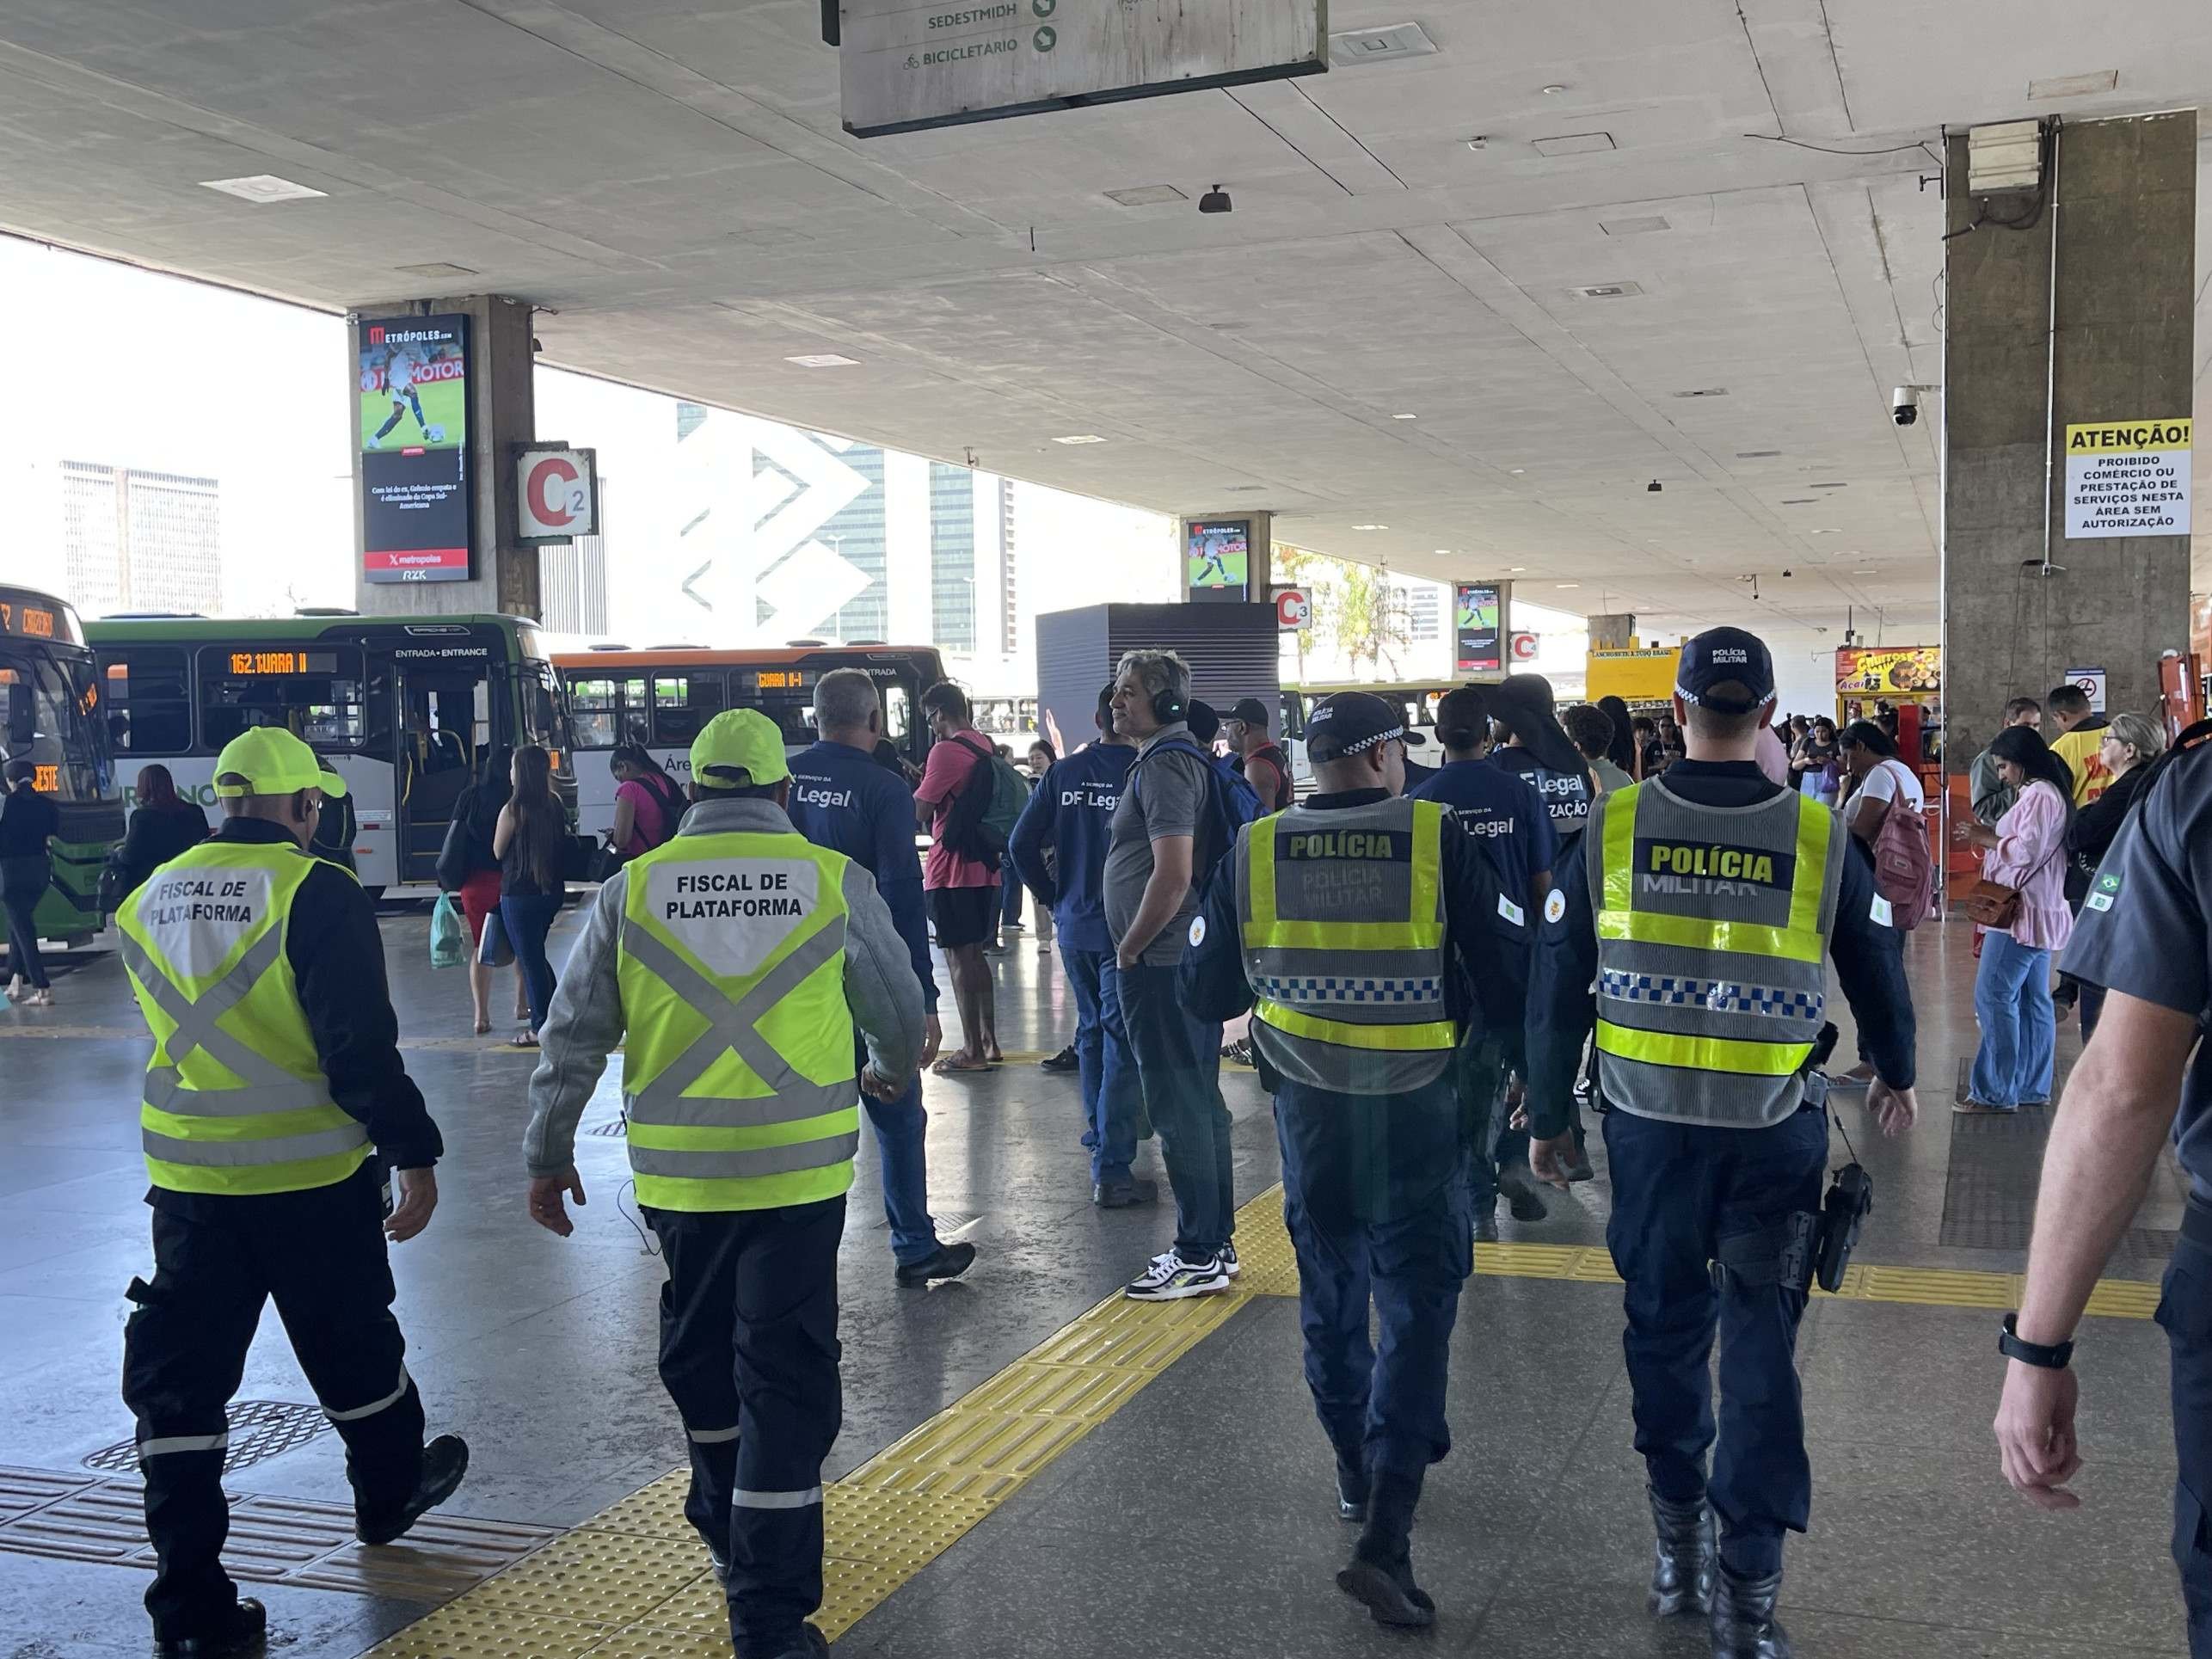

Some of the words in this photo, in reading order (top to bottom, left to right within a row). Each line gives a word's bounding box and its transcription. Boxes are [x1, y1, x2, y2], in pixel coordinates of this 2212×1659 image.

[928, 3, 1017, 29] SEDESTMIDH
[2071, 424, 2190, 450] ATENÇÃO!
[2098, 456, 2160, 467] PROIBIDO
[2083, 469, 2151, 480] COMÉRCIO
[2156, 468, 2174, 476] OU
[2080, 480, 2156, 492] PRESTAÇÃO
[2160, 480, 2178, 488] DE
[572, 490, 586, 511] 2
[2074, 495, 2137, 505] SERVIÇOS
[2141, 492, 2184, 502] NESTA
[2095, 506, 2129, 516] ÁREA
[2134, 505, 2160, 514] SEM
[2082, 516, 2174, 528] AUTORIZAÇÃO
[1300, 606, 1308, 617] 3
[396, 649, 436, 658] ENTRADA
[441, 648, 488, 657] ENTRANCE
[1712, 647, 1747, 656] POLÍCIA
[1712, 655, 1748, 664] MILITAR
[664, 753, 691, 771] Áre
[1537, 774, 1583, 796] Legal
[797, 784, 851, 808] Legal
[1061, 791, 1084, 807] DF
[1548, 800, 1588, 819] ZAÇÃO
[1464, 817, 1515, 839] Legal
[1290, 830, 1392, 858] POLÍCIA
[1650, 845, 1774, 883] POLÍCIA
[159, 882, 214, 900] FISCAL
[220, 882, 247, 897] DE
[677, 874, 753, 893] FISCAL
[760, 874, 788, 890] DE
[151, 904, 251, 926] PLATAFORMA
[667, 899, 802, 919] PLATAFORMA
